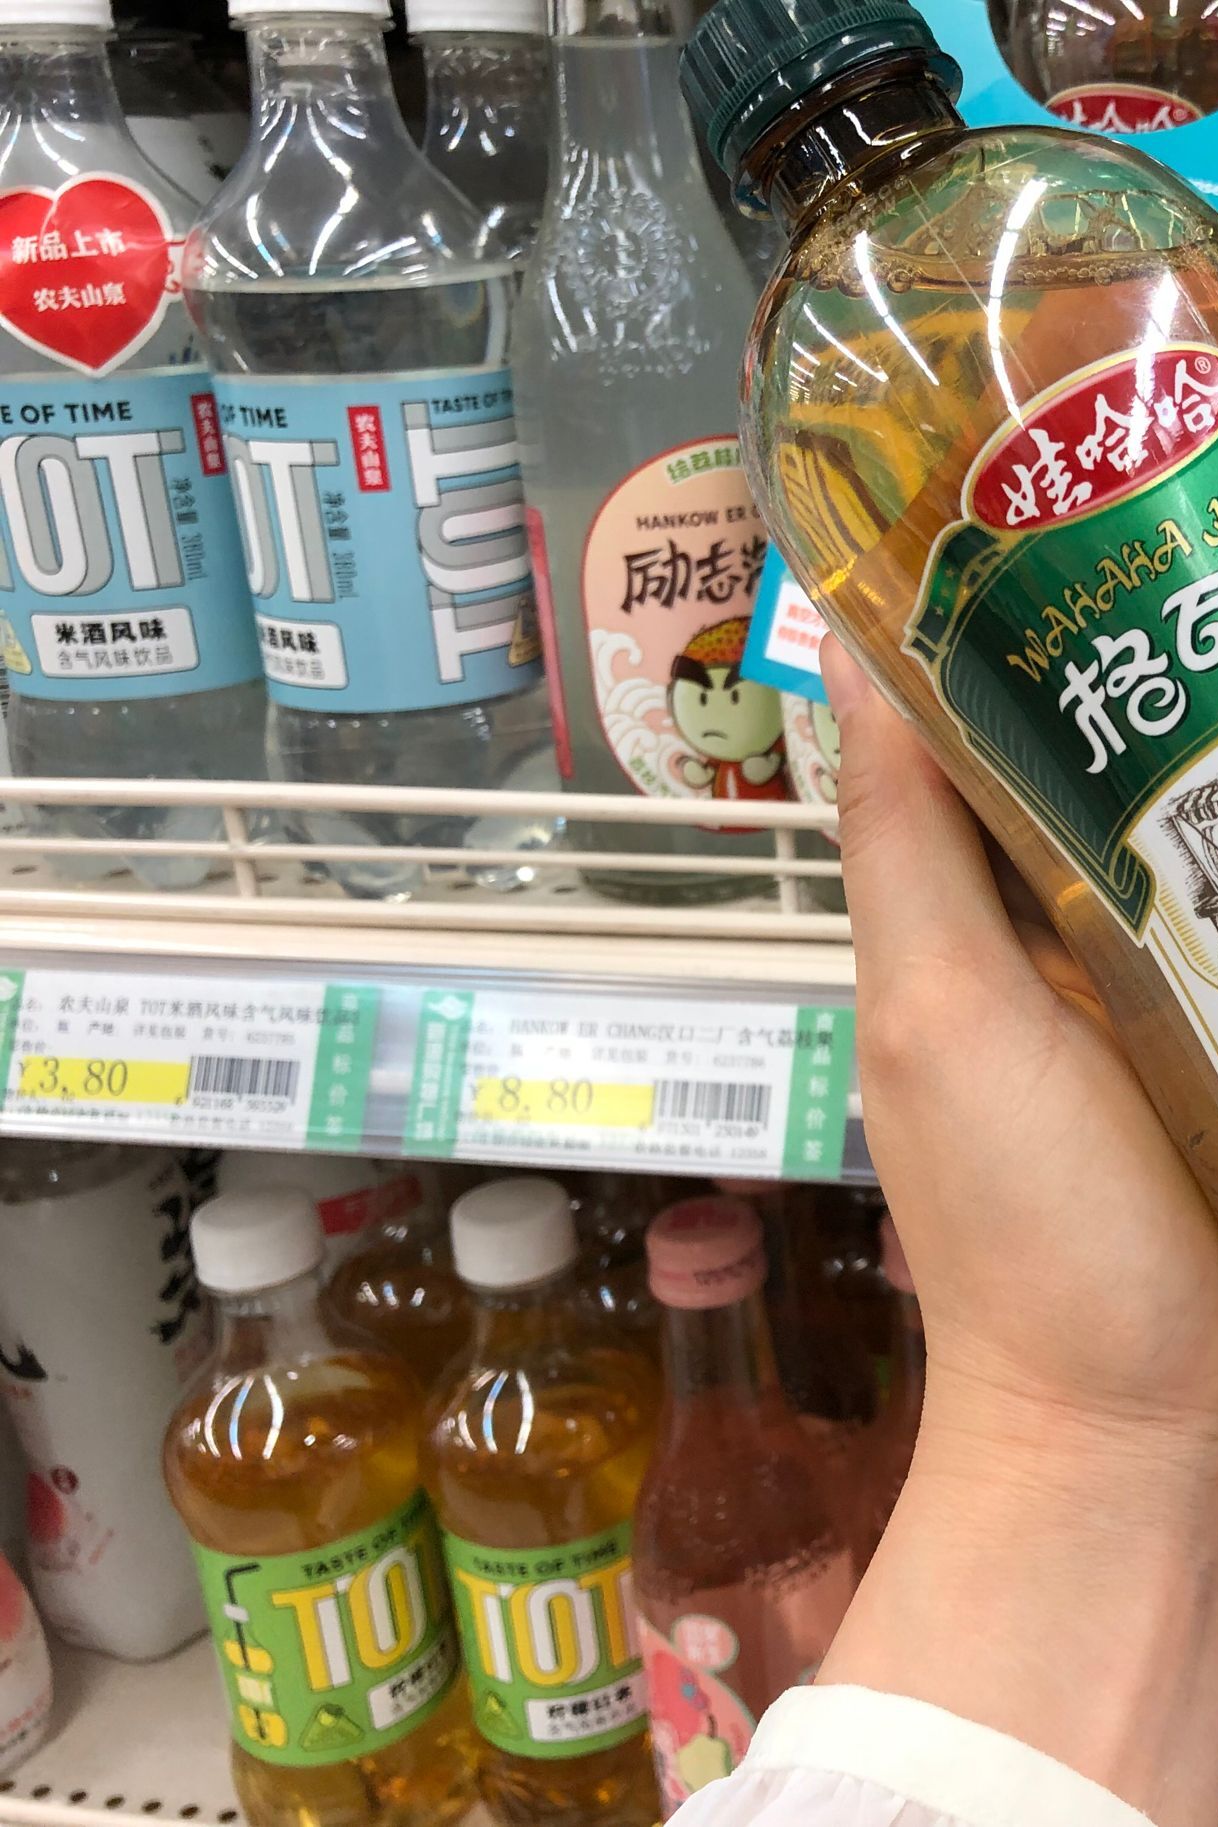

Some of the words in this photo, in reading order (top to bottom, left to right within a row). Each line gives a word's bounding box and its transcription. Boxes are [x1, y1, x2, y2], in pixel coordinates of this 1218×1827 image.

[11, 228, 127, 265] 新品上市
[33, 281, 127, 311] 农夫山泉
[20, 403, 55, 424] OF
[64, 401, 133, 424] TIME
[239, 406, 288, 428] TIME
[0, 427, 186, 598] OT
[636, 509, 718, 532] HANKOW
[1006, 518, 1194, 684] WAHAHA
[55, 619, 168, 646] 米酒风味
[272, 1545, 432, 1693] TO
[456, 1557, 634, 1688] TOT
